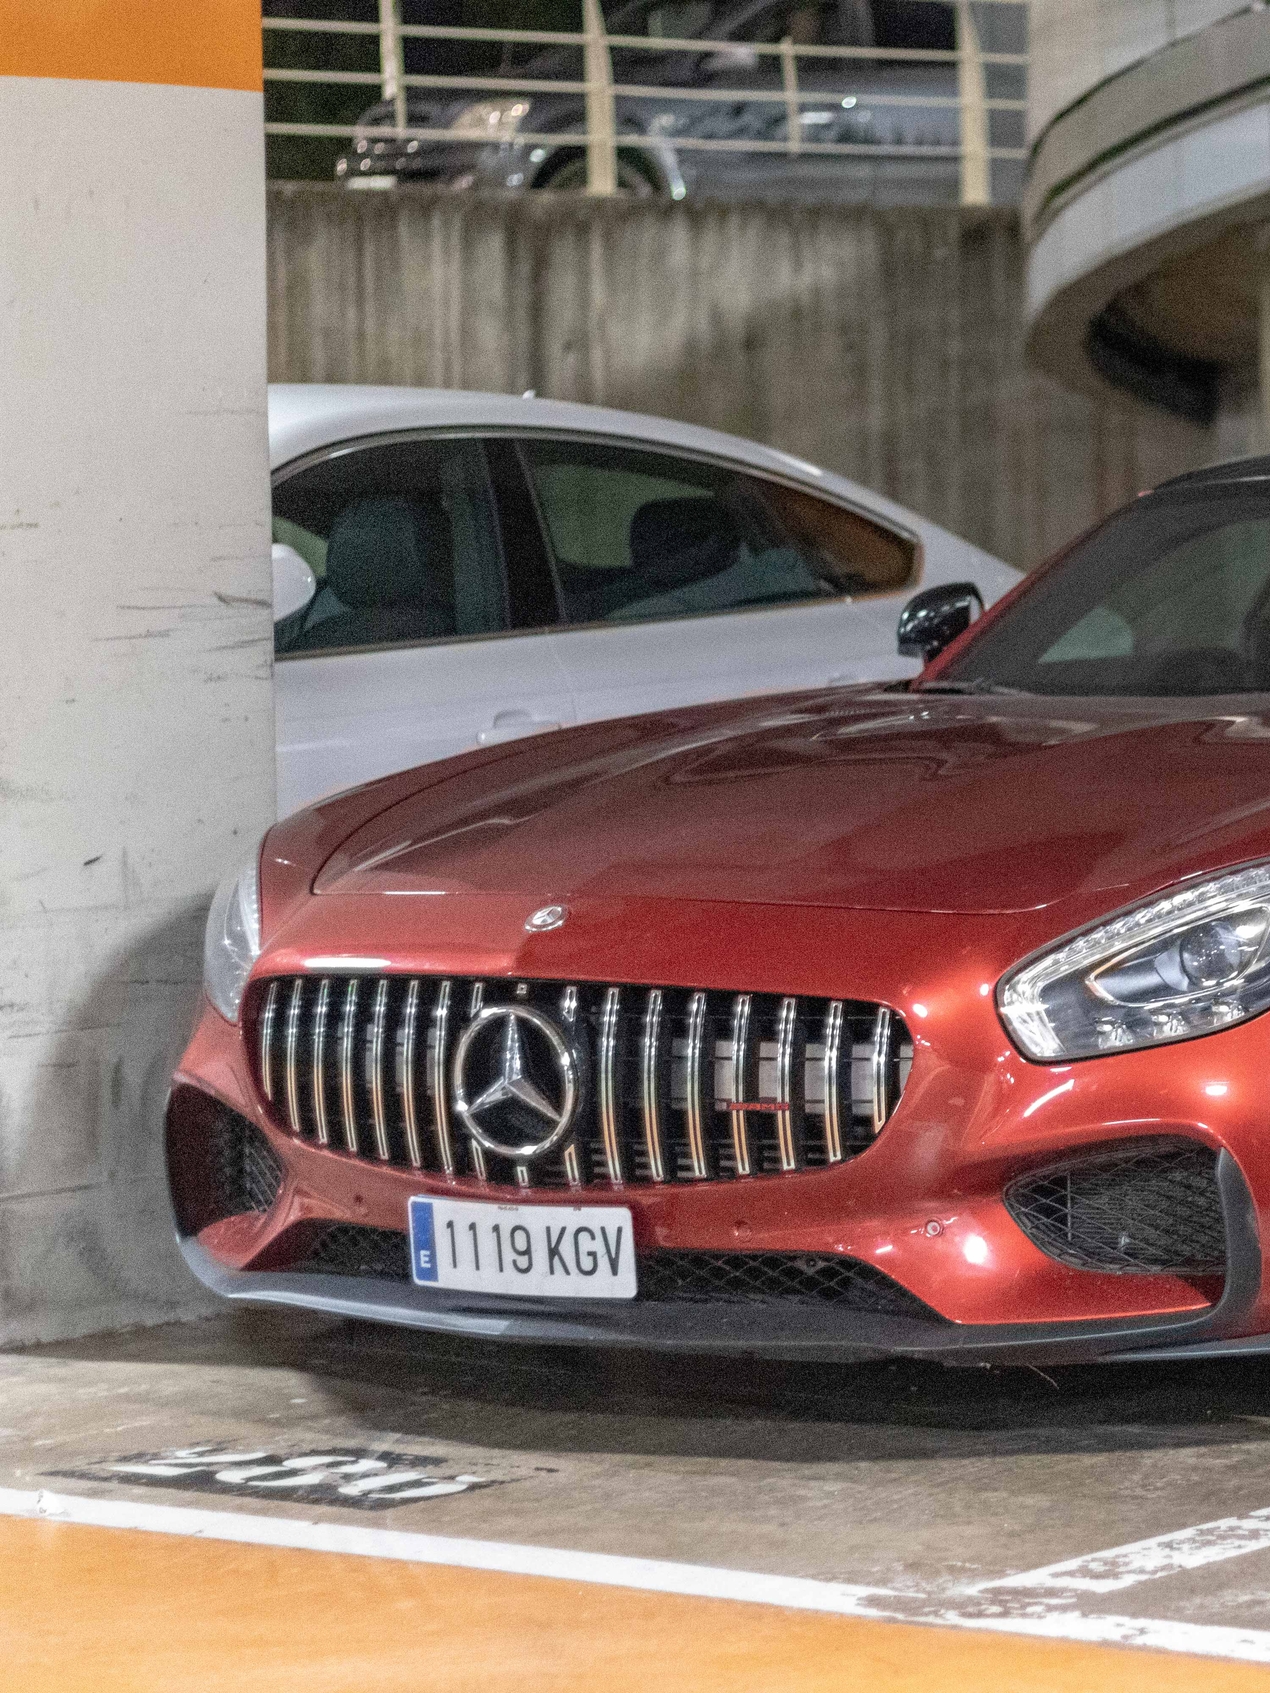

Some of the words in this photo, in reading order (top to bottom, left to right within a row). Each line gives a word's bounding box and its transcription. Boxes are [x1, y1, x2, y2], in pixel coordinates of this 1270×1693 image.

[419, 1250, 432, 1269] E
[446, 1219, 534, 1275] 1119
[545, 1225, 624, 1277] KGV
